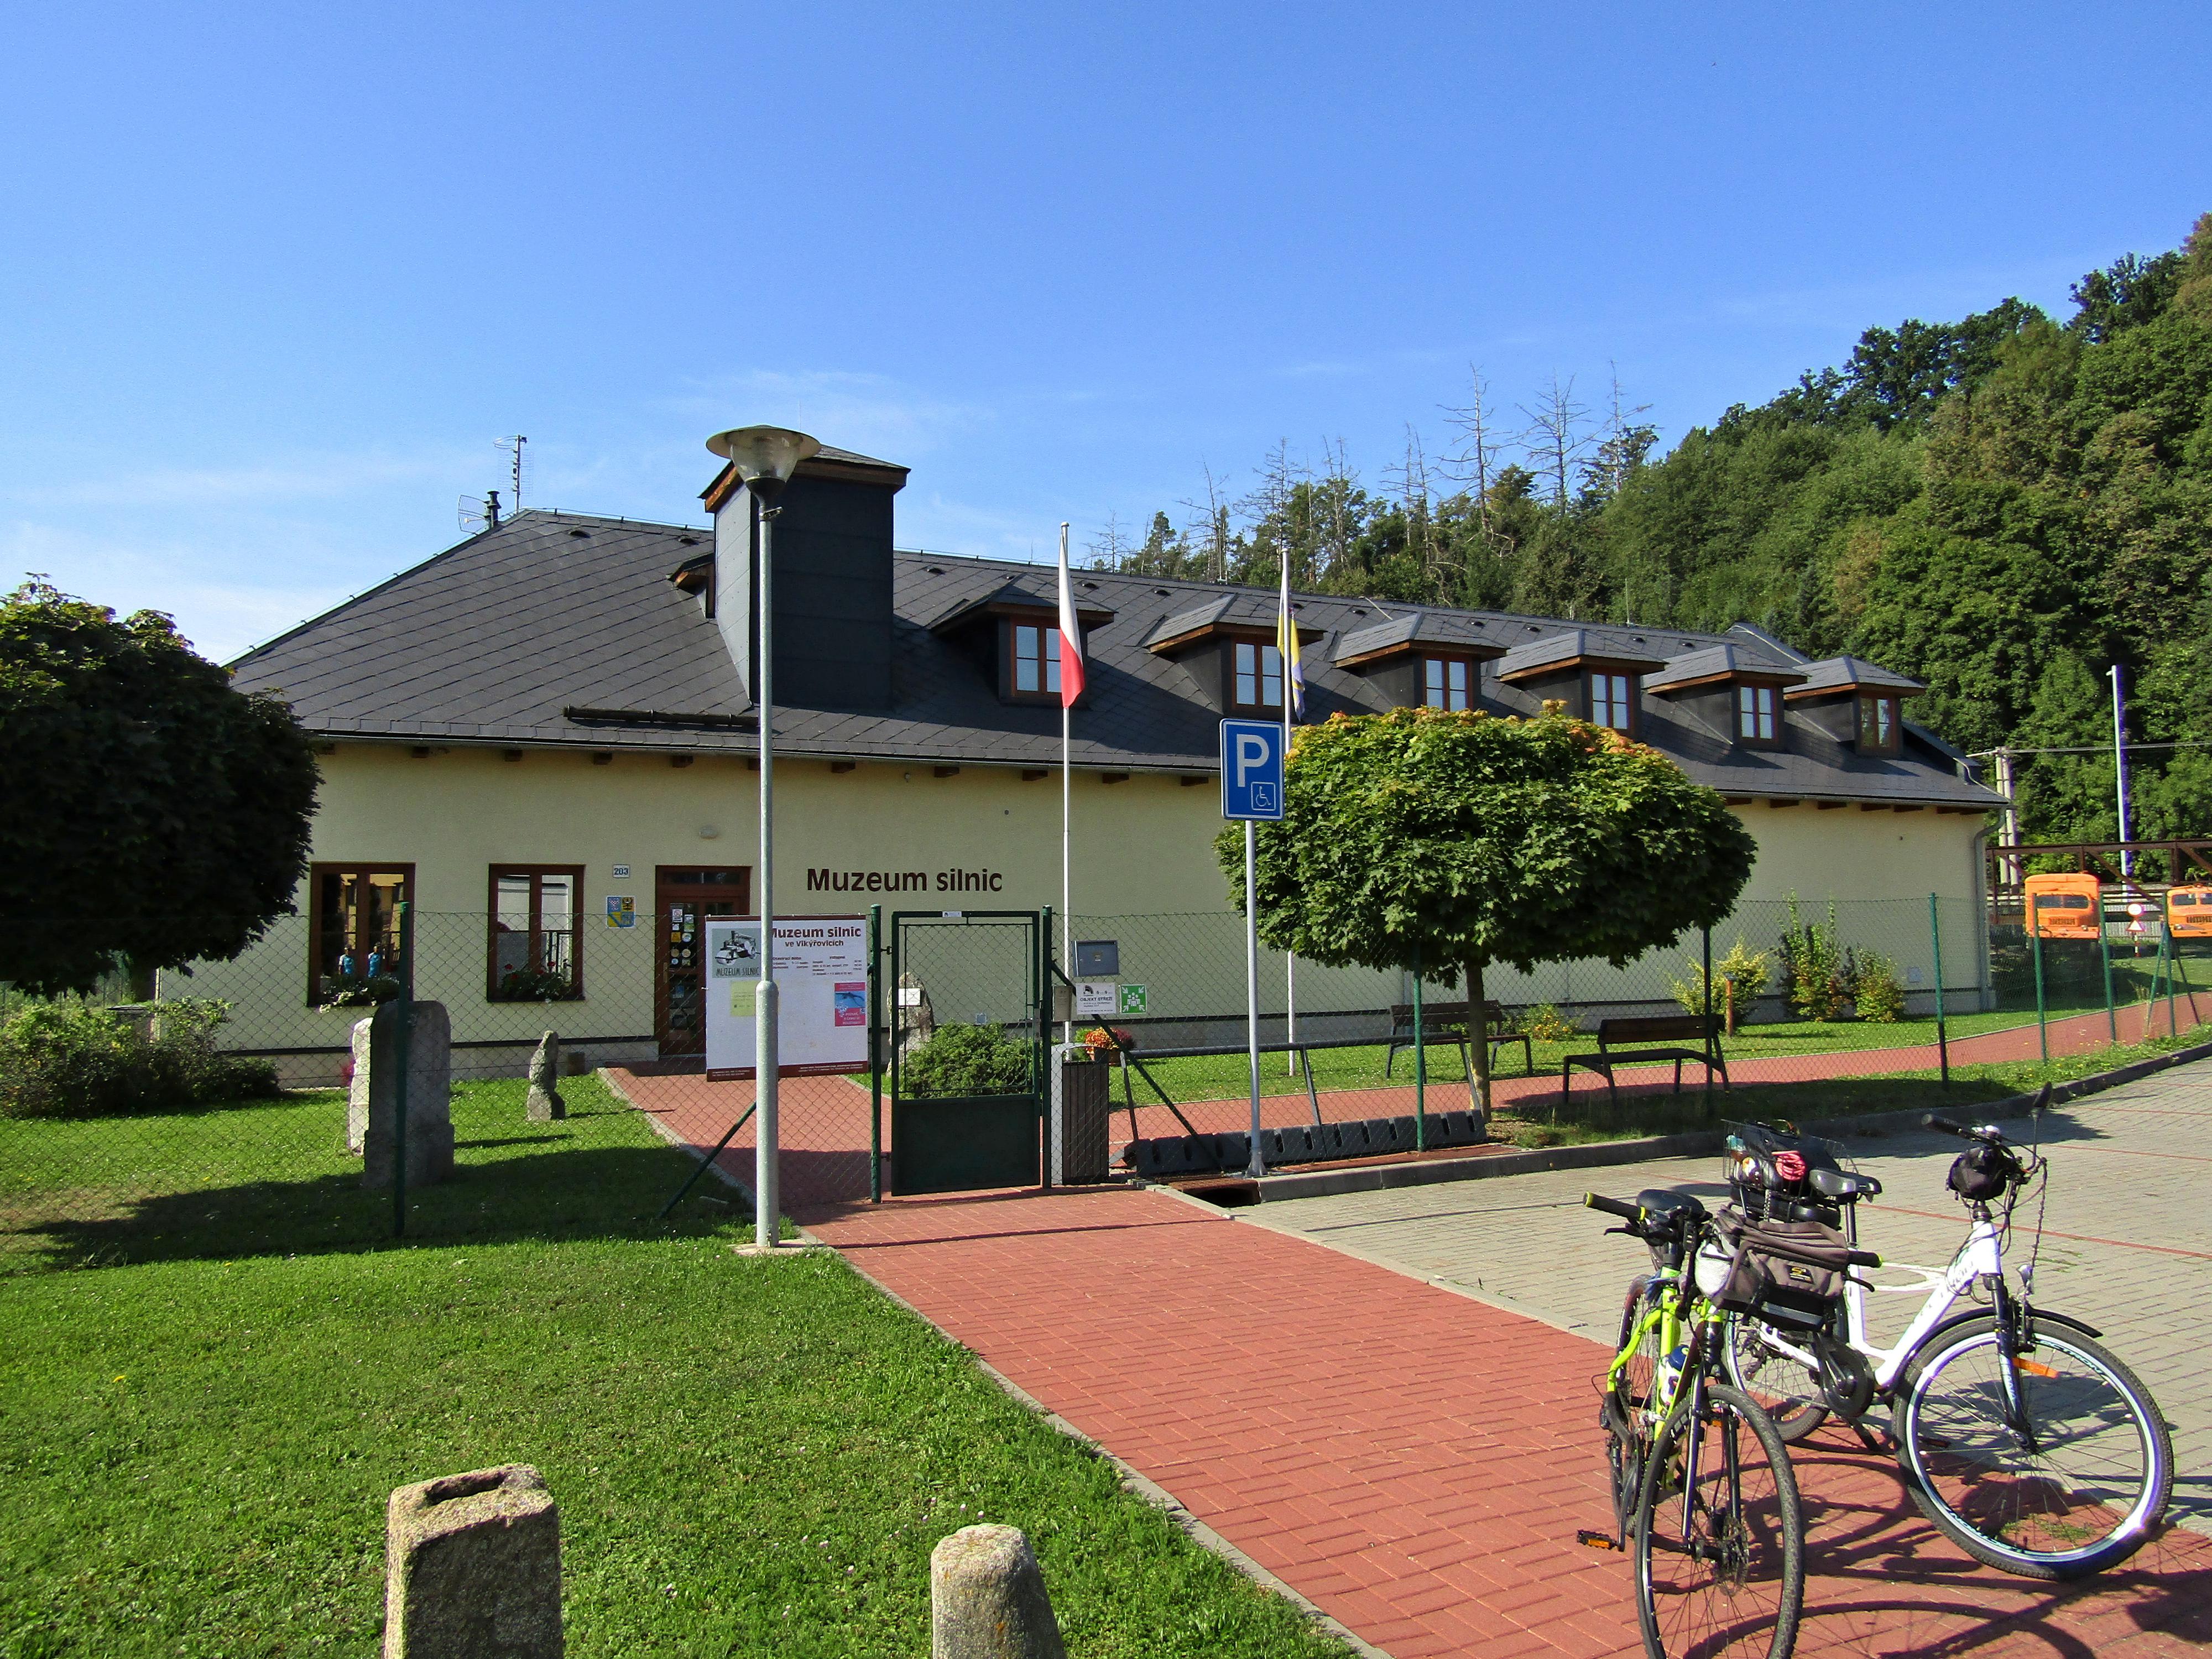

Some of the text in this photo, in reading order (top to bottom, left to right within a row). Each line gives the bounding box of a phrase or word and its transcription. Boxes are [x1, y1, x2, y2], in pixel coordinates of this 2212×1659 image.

[1237, 734, 1269, 787] P
[807, 868, 1003, 891] Muzeum silnic
[827, 926, 862, 938] silnic
[716, 967, 759, 976] MUZEUM SILNIC
